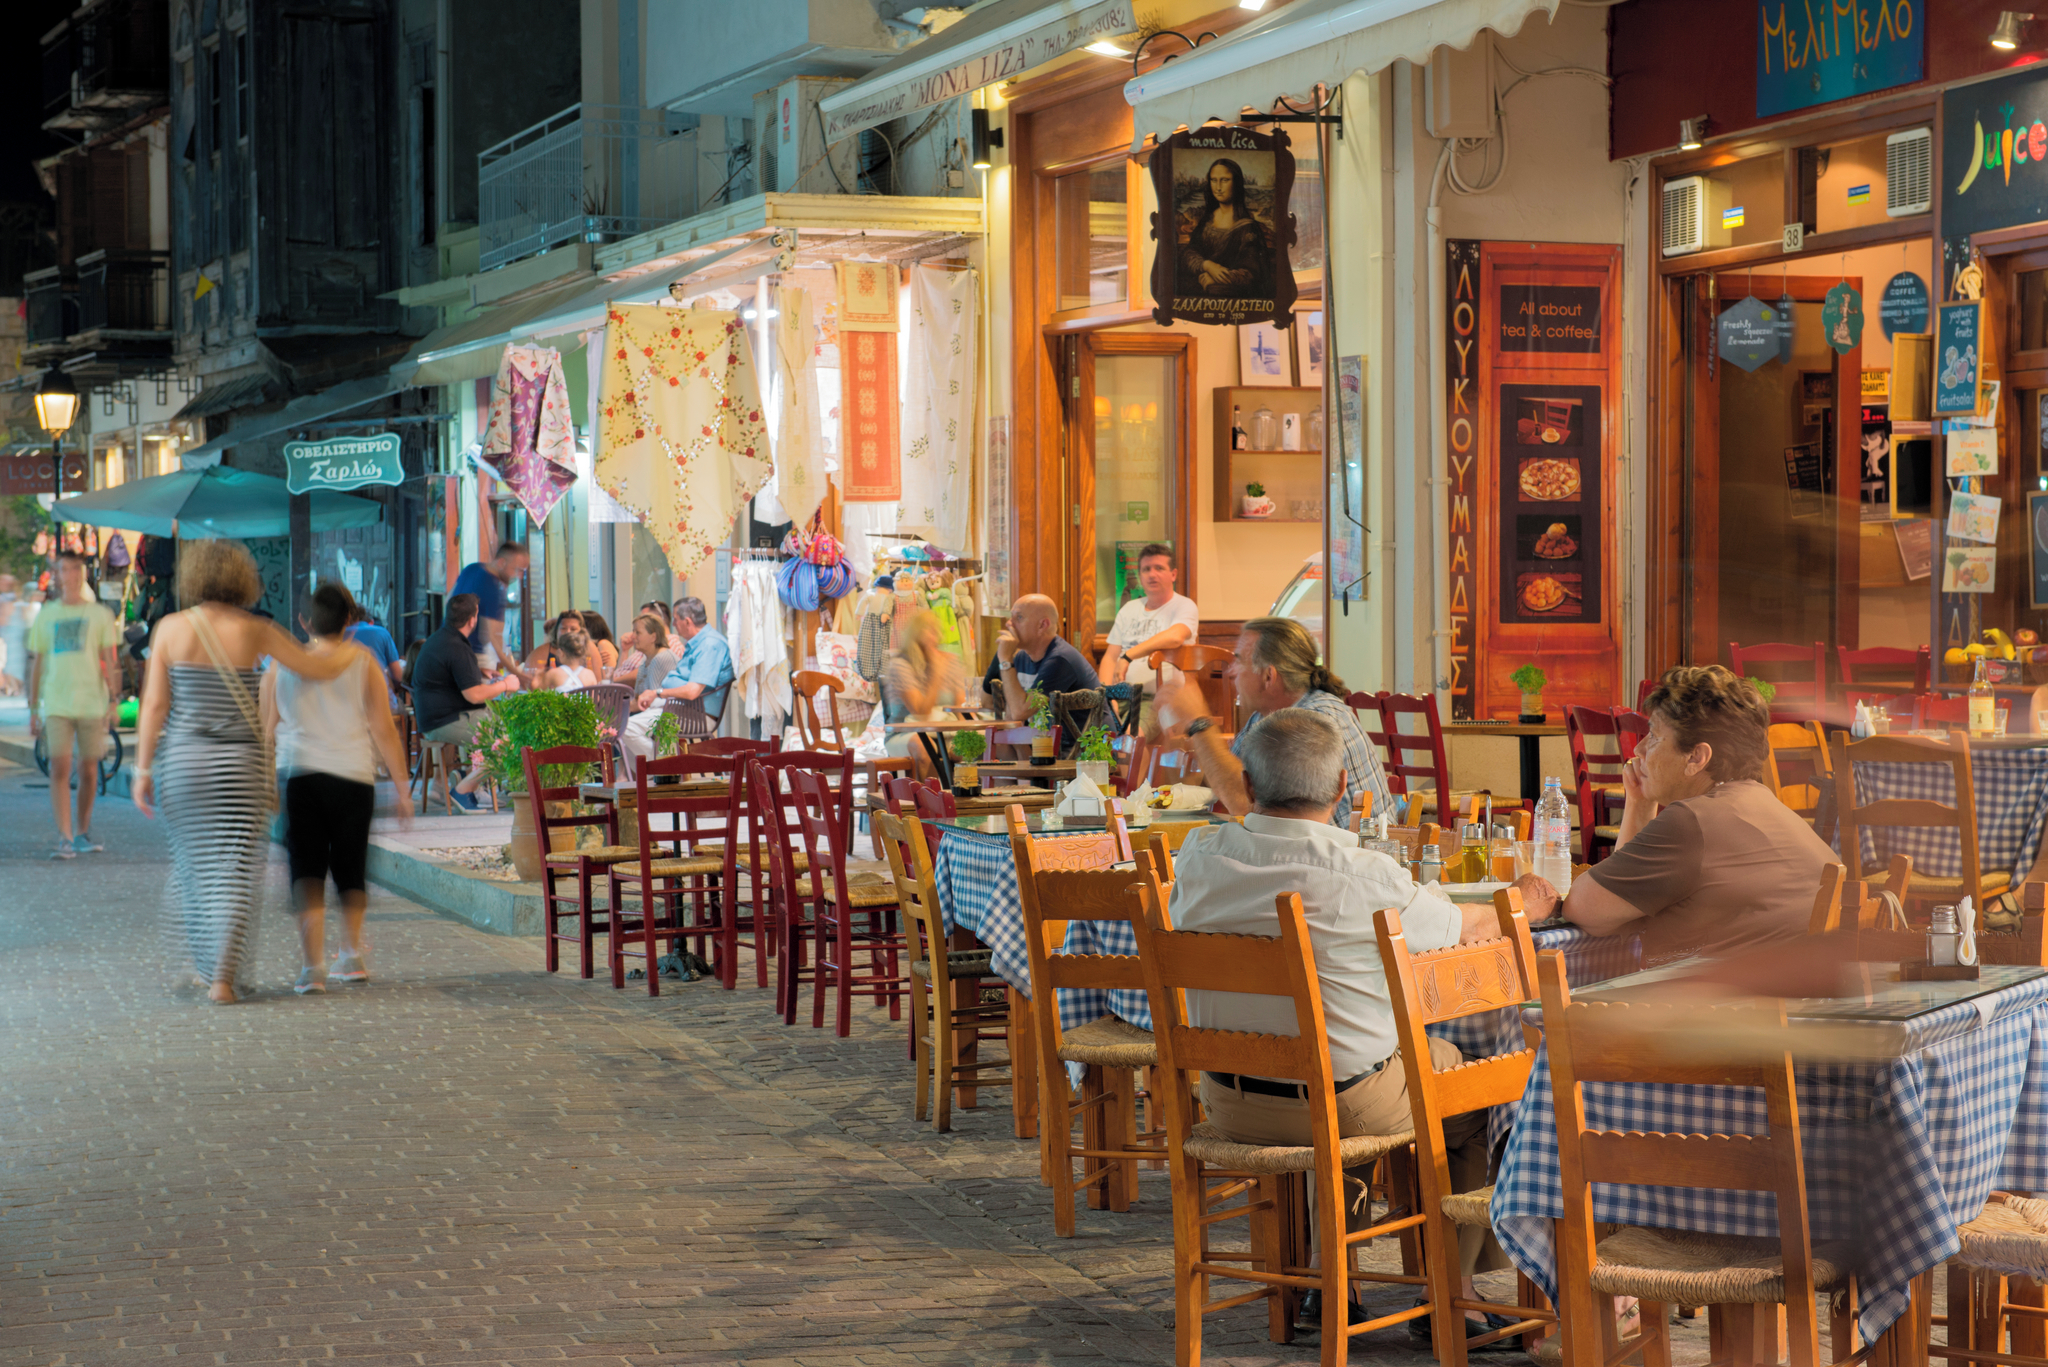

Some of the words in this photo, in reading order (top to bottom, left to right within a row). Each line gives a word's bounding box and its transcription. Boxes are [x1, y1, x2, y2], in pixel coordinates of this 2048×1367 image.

[1189, 137, 1226, 149] mona
[1230, 130, 1258, 150] lisa
[1786, 228, 1799, 248] 38
[1172, 298, 1274, 312] ΖΑΧΑΡΟΠΛΑΣΤΕΙΟ
[1519, 301, 1535, 315] All
[1539, 302, 1583, 316] about
[1722, 318, 1752, 330] Freshly
[1949, 308, 1974, 325] yoghurt
[1501, 323, 1526, 337] tea
[1531, 324, 1541, 338] &
[1955, 326, 1973, 338] fruits
[293, 440, 392, 459] ΟΒΕΛΙΣΤΗΡΙΟ
[8, 463, 82, 479] LOCO
[1450, 263, 1475, 696] ΛΟΥΚΟΥΜΑΔΕΣ
